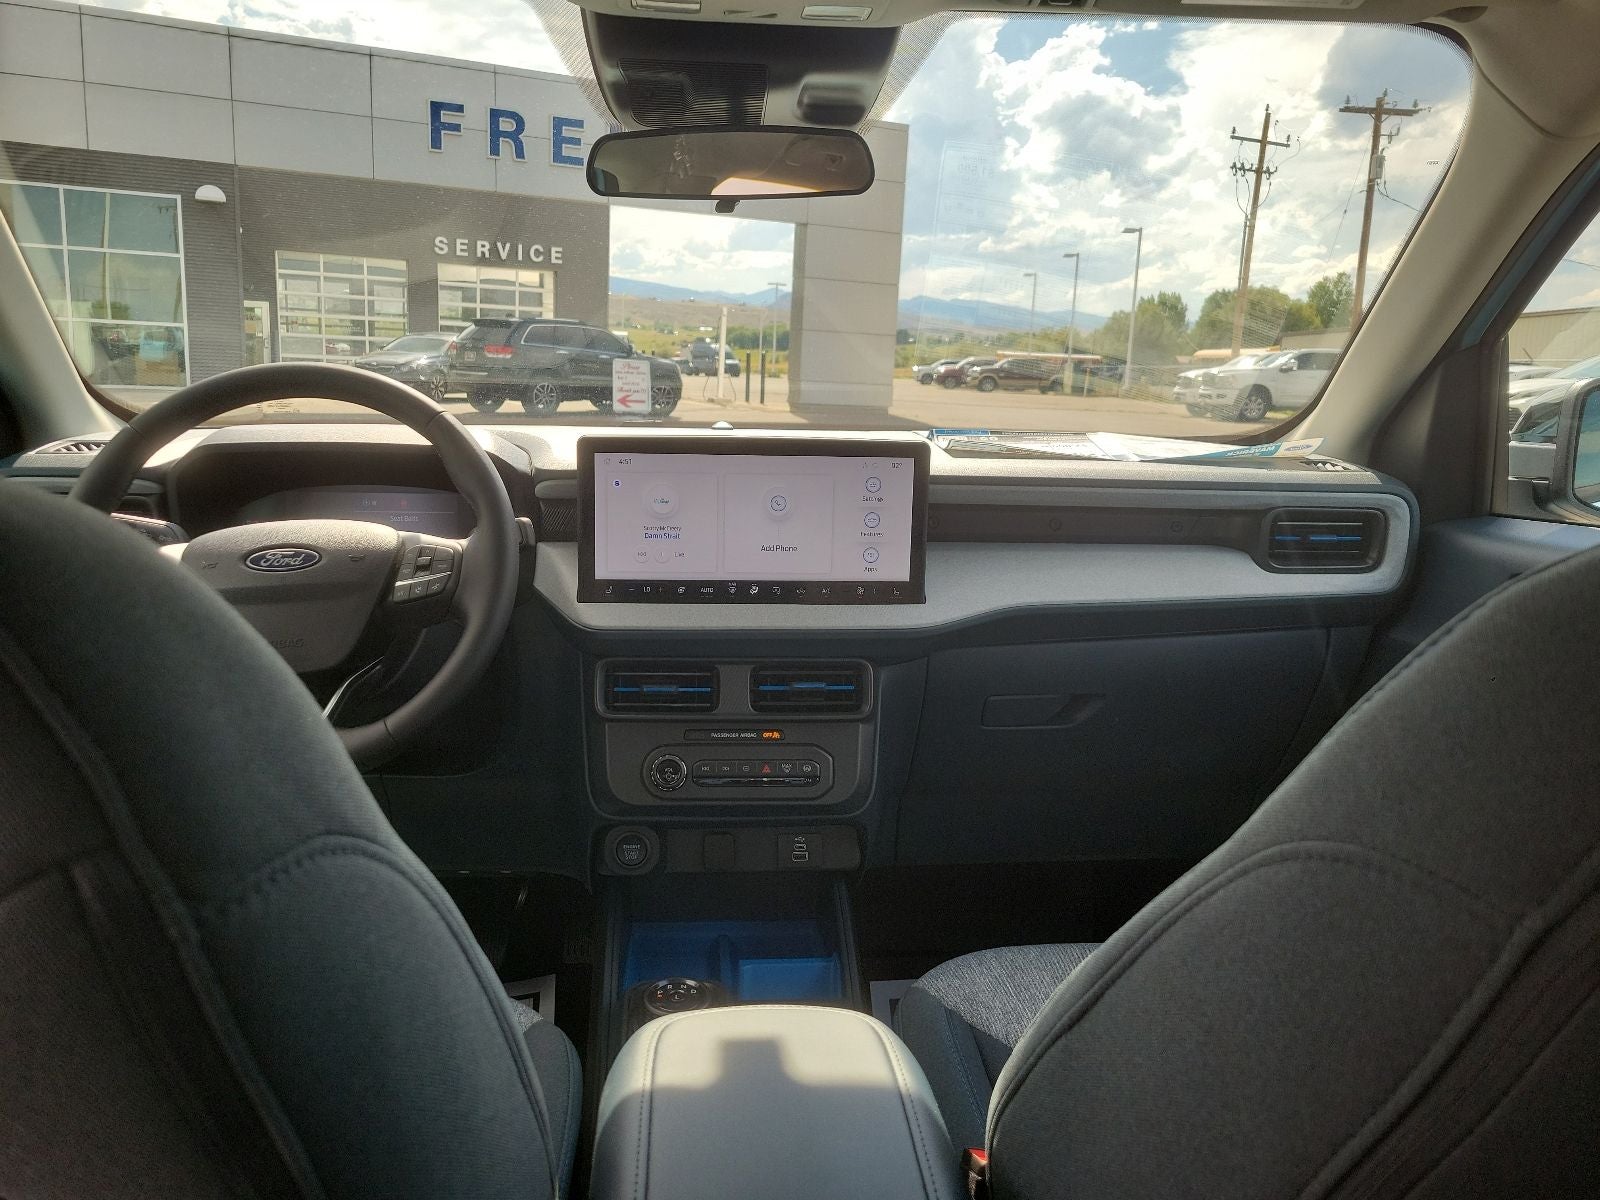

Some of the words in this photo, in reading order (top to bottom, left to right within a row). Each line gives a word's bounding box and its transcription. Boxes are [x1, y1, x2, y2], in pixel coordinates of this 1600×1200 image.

[429, 99, 585, 168] FRE
[434, 237, 563, 264] SERVICE
[644, 532, 663, 540] Damn
[663, 532, 681, 540] Strait
[760, 544, 775, 552] Add
[775, 544, 798, 552] Phone
[259, 551, 304, 569] Ford
